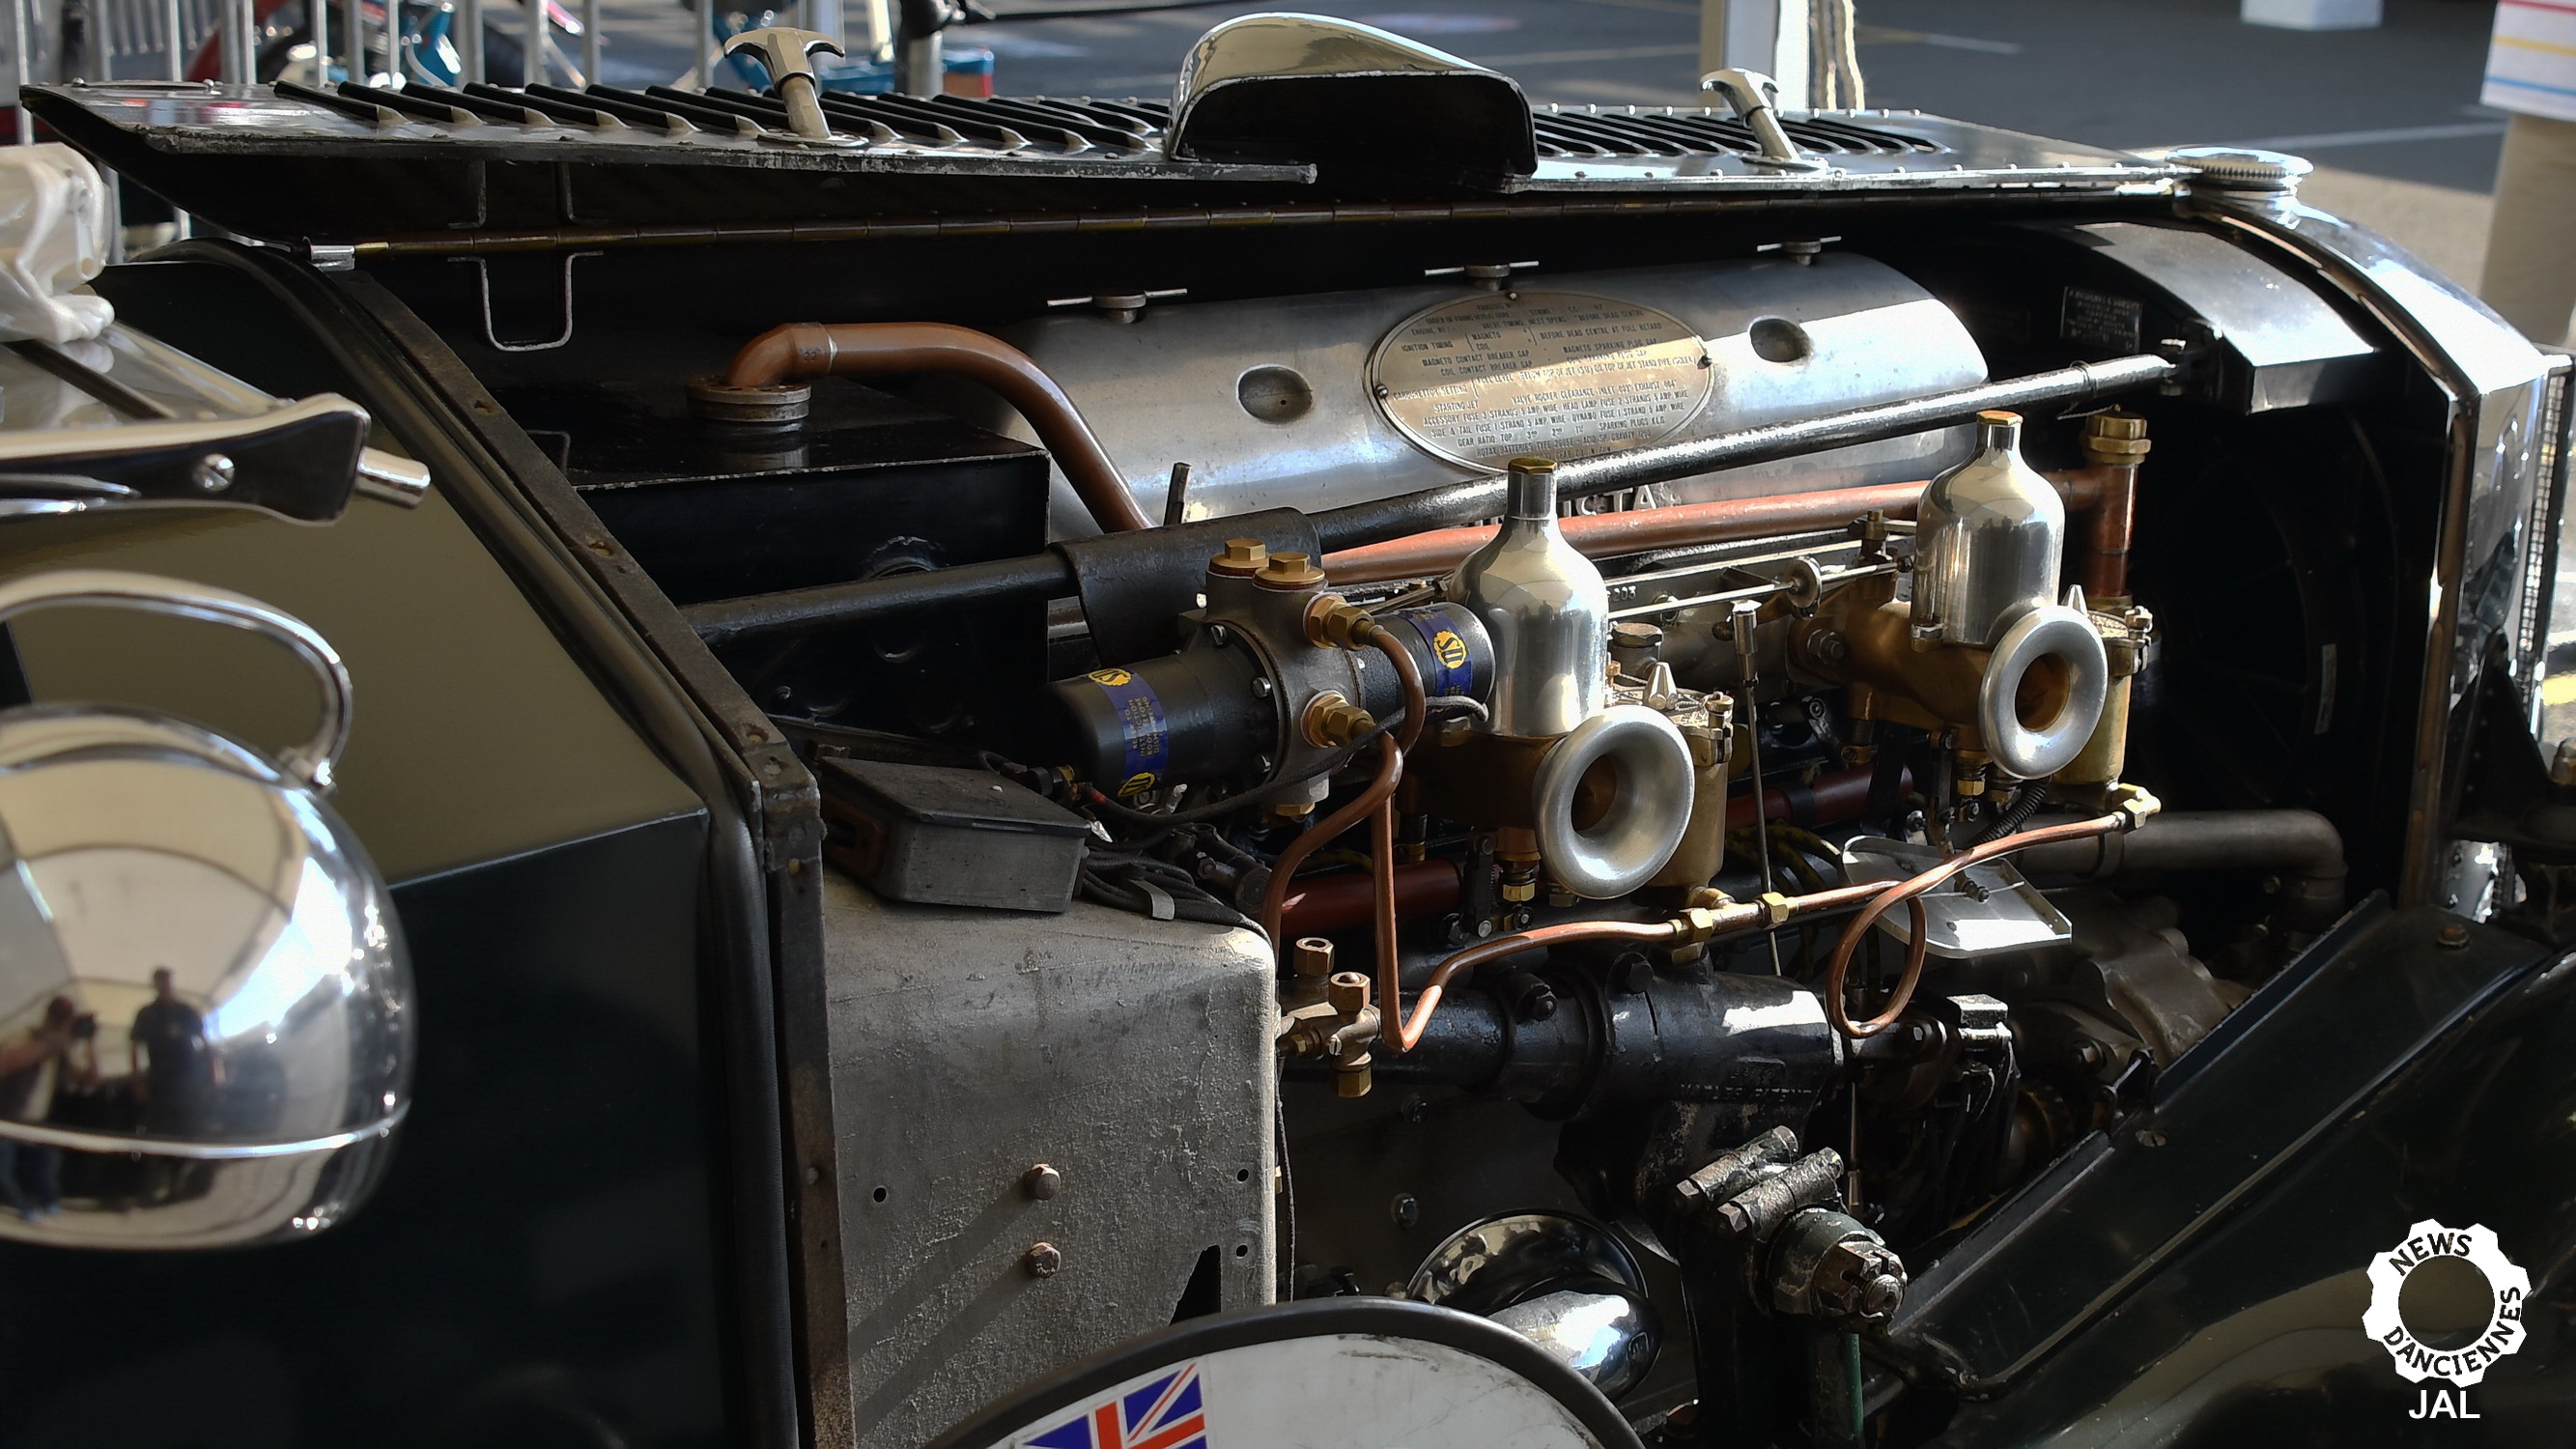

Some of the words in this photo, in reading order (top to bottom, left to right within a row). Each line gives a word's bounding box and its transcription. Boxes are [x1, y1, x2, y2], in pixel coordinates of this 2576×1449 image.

[1602, 310, 1619, 319] DEAD
[1621, 308, 1644, 318] CENTRE
[1471, 332, 1502, 342] MAGNETO
[1540, 329, 1565, 339] BEFORE
[1567, 328, 1583, 337] DEAD
[1585, 326, 1609, 336] CENTRE
[1611, 325, 1620, 333] AT
[1622, 324, 1637, 332] FULL
[1639, 322, 1663, 331] RETARD
[1401, 343, 1429, 353] IGNITION
[1476, 343, 1491, 352] COIL
[1563, 343, 1592, 354] MAGNETO
[1594, 340, 1627, 351] SPARKING
[1422, 356, 1454, 367] MAGNETO
[1455, 354, 1484, 364] CONTACT
[1487, 351, 1516, 361] BREAKER
[1517, 350, 1530, 358] GAP
[1440, 367, 1457, 377] COIL
[1458, 364, 1487, 375] CONTACT
[1489, 361, 1518, 372] BREAKER
[1519, 359, 1533, 369] GAP
[1511, 394, 1531, 405] VALVE
[1534, 392, 1559, 402] ROCKER
[1560, 388, 1595, 400] CLEARANCE
[1423, 414, 1460, 427] ACCESSORY
[1463, 412, 1480, 423] FUSE
[1489, 410, 1518, 419] STRANDS
[1527, 406, 1541, 415] AMP
[1542, 404, 1558, 413] WIRE
[1563, 401, 1579, 411] HEAD
[1581, 399, 1598, 410] LAMP
[1599, 397, 1615, 407] FUSE
[1625, 393, 1652, 405] STRANDS
[1659, 391, 1672, 401] AMP
[1674, 389, 1689, 399] WIRE
[1433, 401, 1466, 413] STARTING
[1467, 400, 1479, 410] JET
[1430, 428, 1447, 439] SIDE
[1458, 425, 1474, 435] TAIL
[1476, 422, 1492, 432] FUSE
[1499, 419, 1525, 430] STRAND
[1534, 416, 1547, 426] AMP
[1550, 414, 1567, 424] WIRE
[1571, 412, 1598, 422] DYNAMO
[1599, 409, 1616, 418] FUSE
[1623, 406, 1647, 416] STRAND
[1656, 404, 1668, 412] AMP
[1670, 402, 1685, 412] WIRE
[1457, 438, 1475, 447] GEAR
[1500, 434, 1514, 443] TOP
[1599, 419, 1628, 431] SPARKING
[1630, 417, 1650, 428] PLUGS
[1476, 445, 1497, 458] ROTAX
[1499, 441, 1534, 456] BATTERIES
[1536, 439, 1552, 450] TYPE
[1582, 434, 1597, 446] ACID
